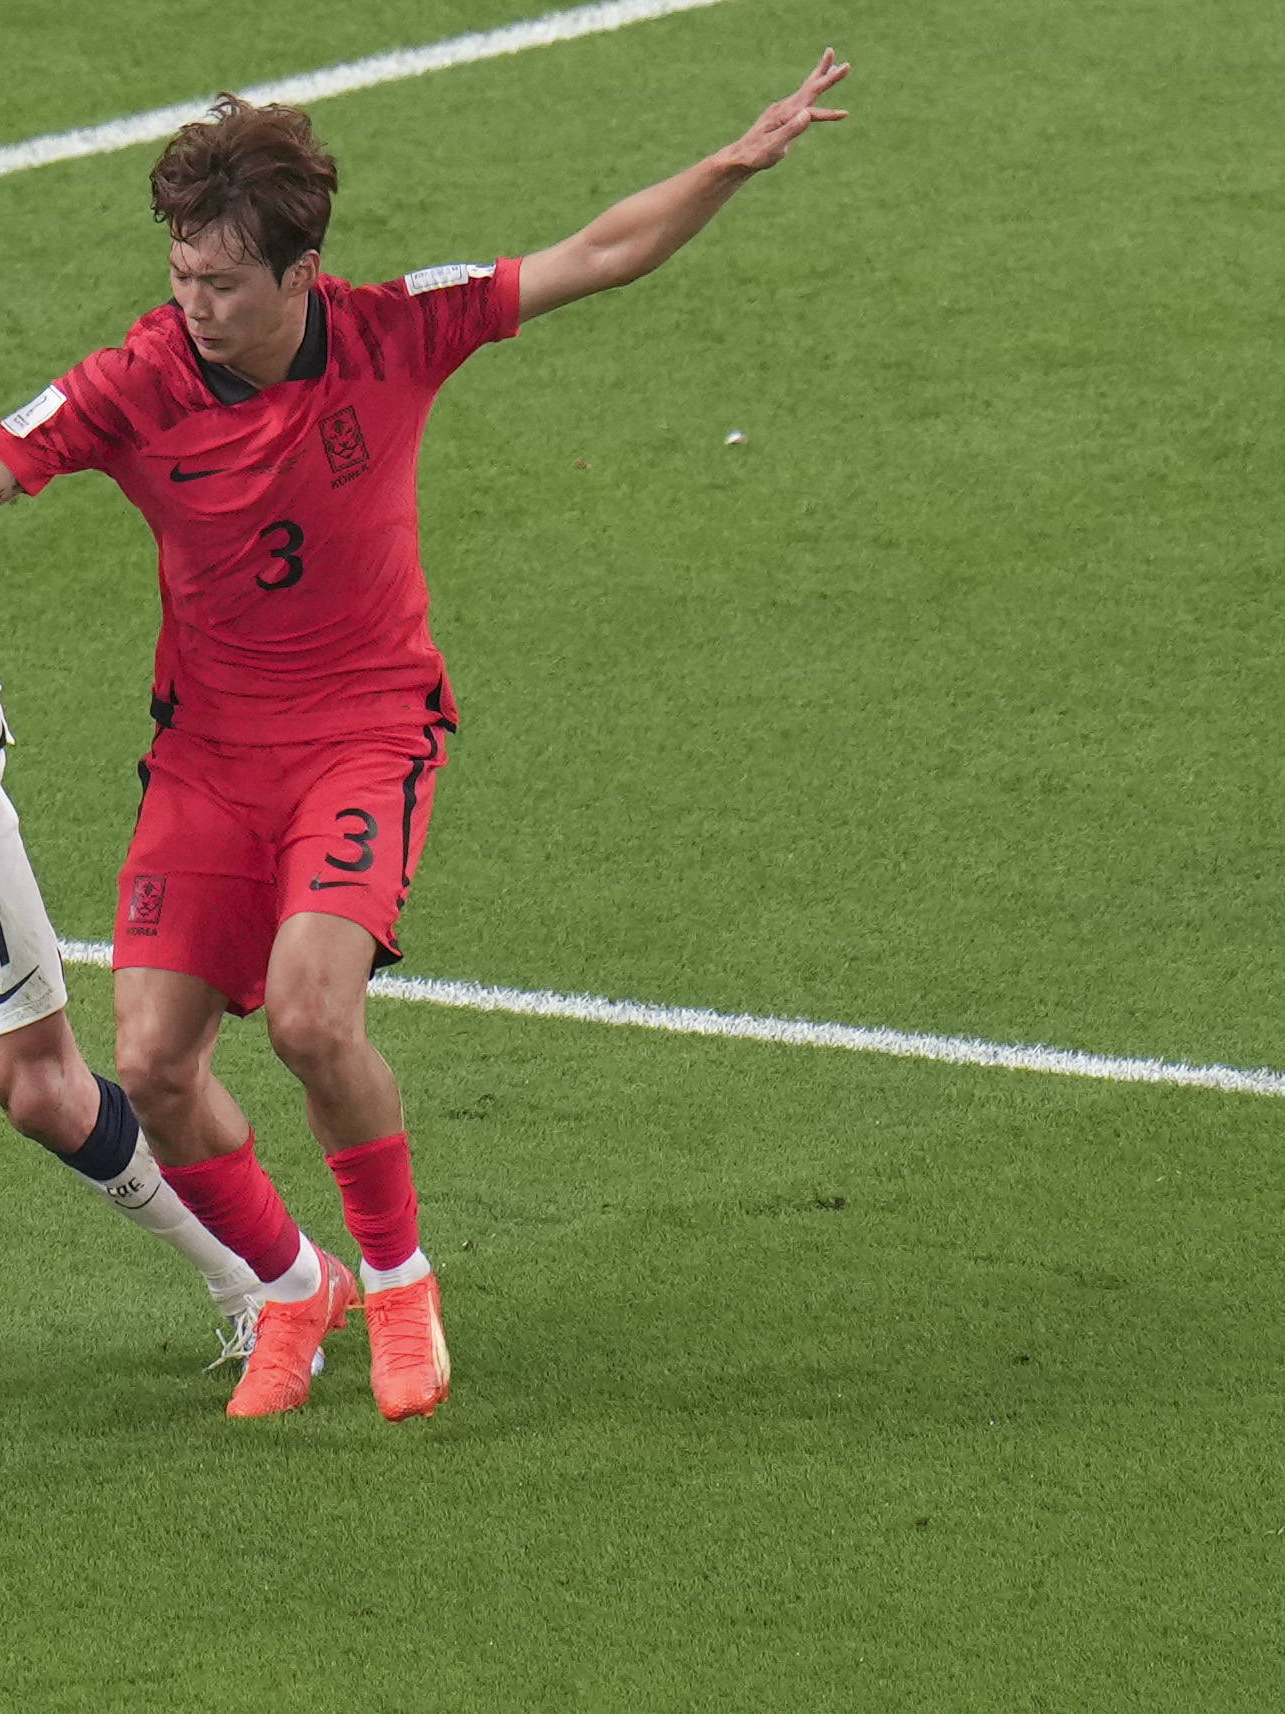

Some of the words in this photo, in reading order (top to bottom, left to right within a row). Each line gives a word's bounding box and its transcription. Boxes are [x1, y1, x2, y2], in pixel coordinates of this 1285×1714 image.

[330, 463, 371, 489] KOREA
[256, 520, 304, 591] 3
[325, 807, 379, 872] 3
[126, 927, 158, 936] KOREA
